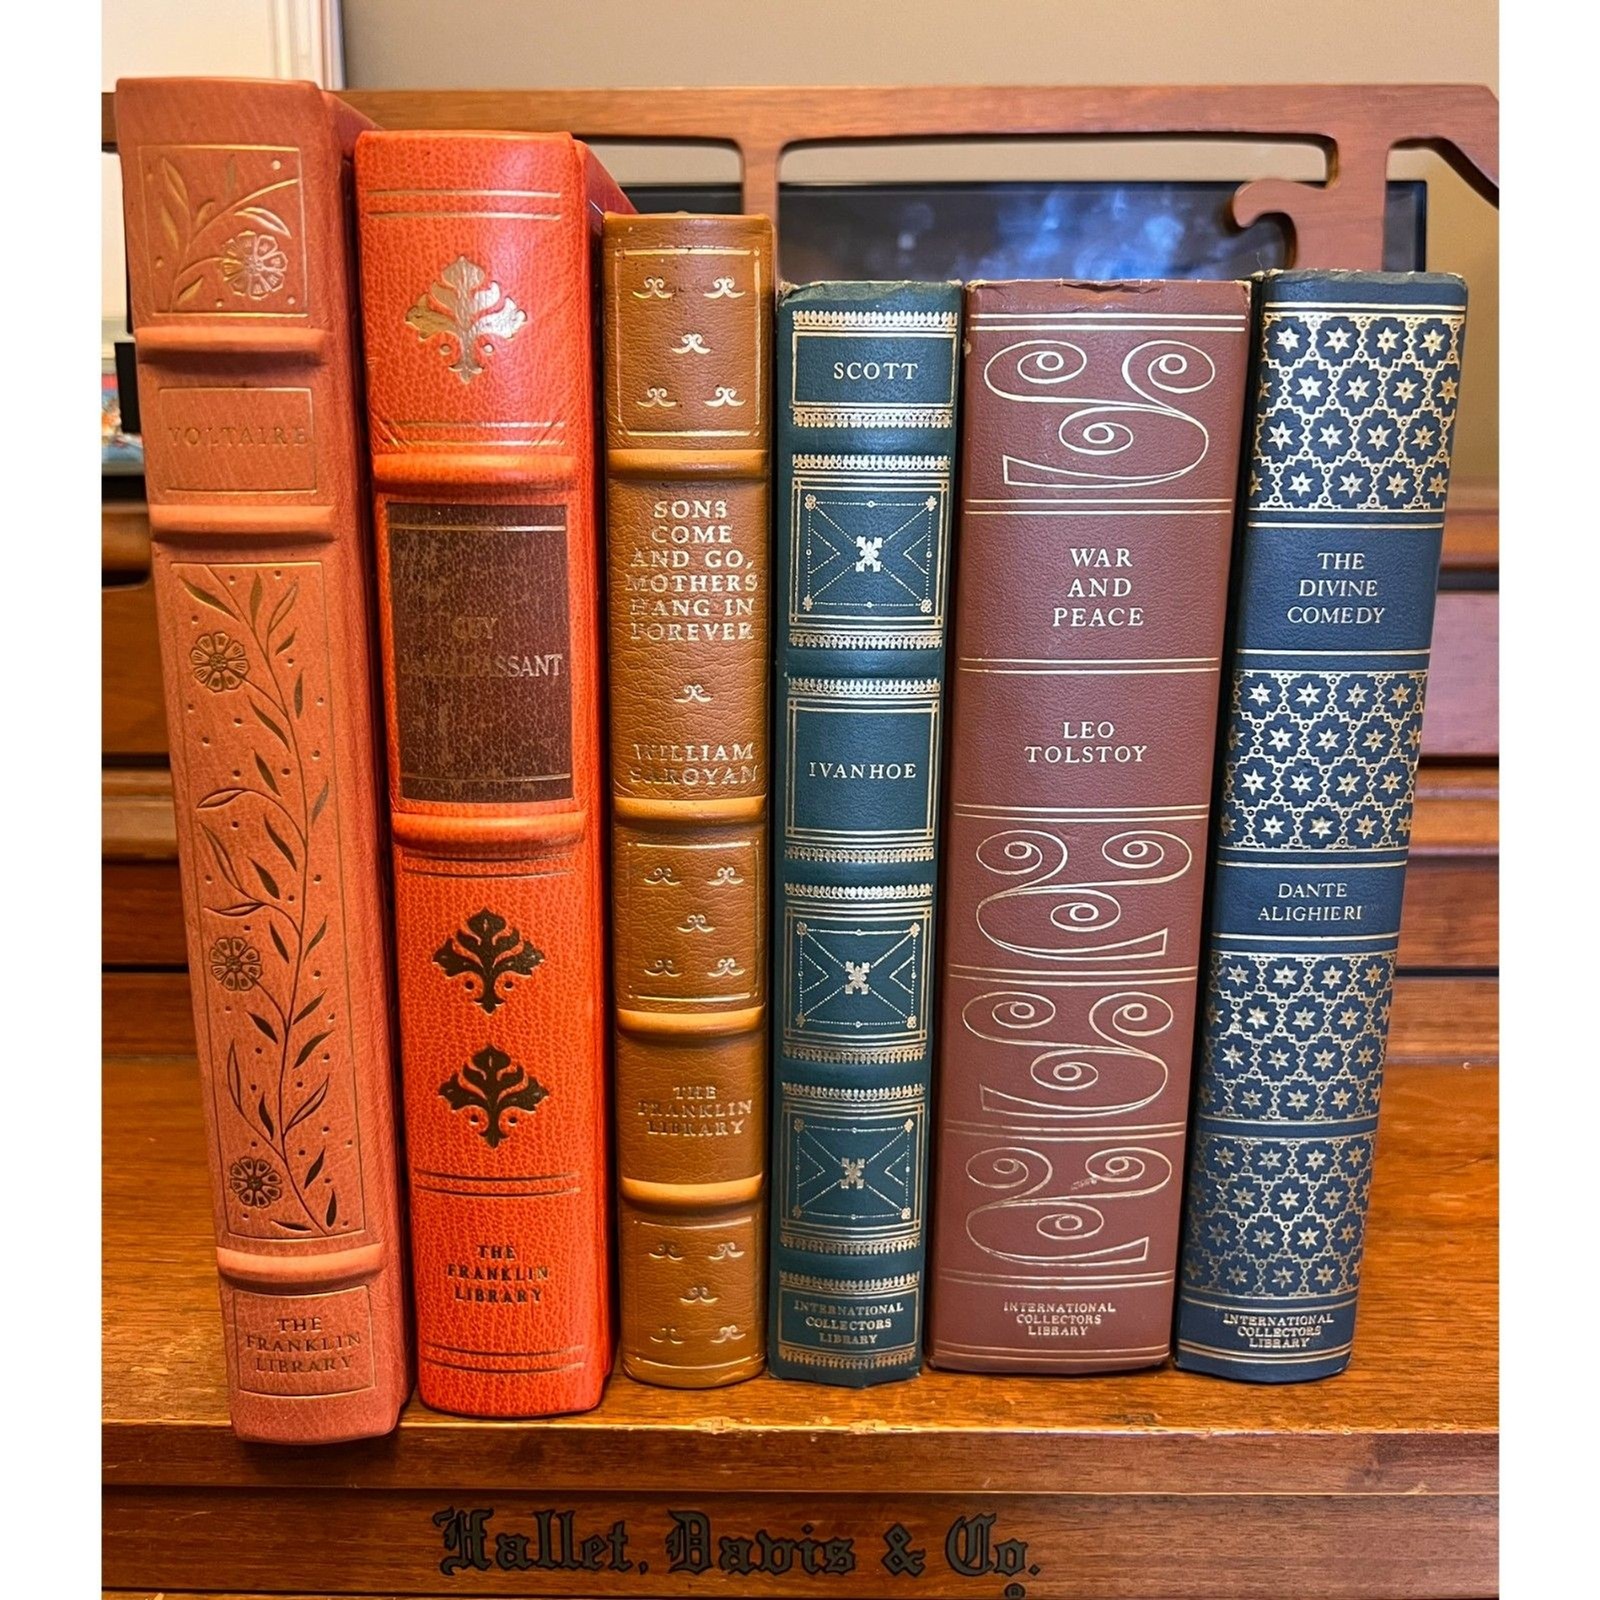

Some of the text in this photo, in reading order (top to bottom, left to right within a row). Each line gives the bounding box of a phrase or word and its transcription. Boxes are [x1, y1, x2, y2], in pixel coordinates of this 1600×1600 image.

[833, 361, 919, 380] SCOTT
[168, 427, 307, 446] VOLTAIRE
[653, 500, 728, 519] SONS
[651, 525, 733, 544] COME
[630, 547, 755, 569] AND GO,
[1069, 547, 1134, 568] WAR
[1316, 552, 1365, 570] THE
[625, 572, 758, 593] MOTHERS
[1066, 577, 1132, 598] AND
[1298, 579, 1379, 597] DIVINE
[630, 598, 755, 617] HANG IN
[1286, 606, 1386, 624] COMEDY
[1052, 607, 1145, 628] PEACE
[630, 621, 755, 641] FOREVER
[1062, 721, 1116, 739] LEO
[632, 741, 754, 763] WILLIAM
[1024, 745, 1148, 763] TOLSTOY
[808, 761, 917, 780] IVANHOE
[1277, 882, 1349, 899] DANTE
[1257, 905, 1363, 922] ALIGHIERI
[672, 1085, 717, 1100] THE
[637, 1099, 753, 1118] FRANKLIN
[646, 1119, 745, 1137] LIBRARY
[477, 1244, 516, 1260] THE
[446, 1263, 549, 1281] FRANKLIN
[454, 1286, 542, 1304] LIBRARY
[793, 1300, 905, 1317] INTERNATIONAL
[1003, 1301, 1117, 1314] INTERNATIONAL
[277, 1316, 322, 1334] THE
[804, 1316, 893, 1332] COLLECTORS
[1016, 1313, 1103, 1326] COLLECTORS
[1222, 1312, 1335, 1327] INTERNATIONAL
[819, 1332, 878, 1346] LIBRARY
[1028, 1325, 1089, 1337] LIBRARY
[1237, 1325, 1323, 1339] COLLECTORS
[245, 1331, 362, 1353] FRANKLIN
[1248, 1337, 1311, 1349] LIBRARY
[255, 1355, 353, 1374] LIBRARY
[665, 1508, 856, 1576] Davis
[881, 1522, 926, 1578] &
[944, 1512, 1041, 1577] Co.
